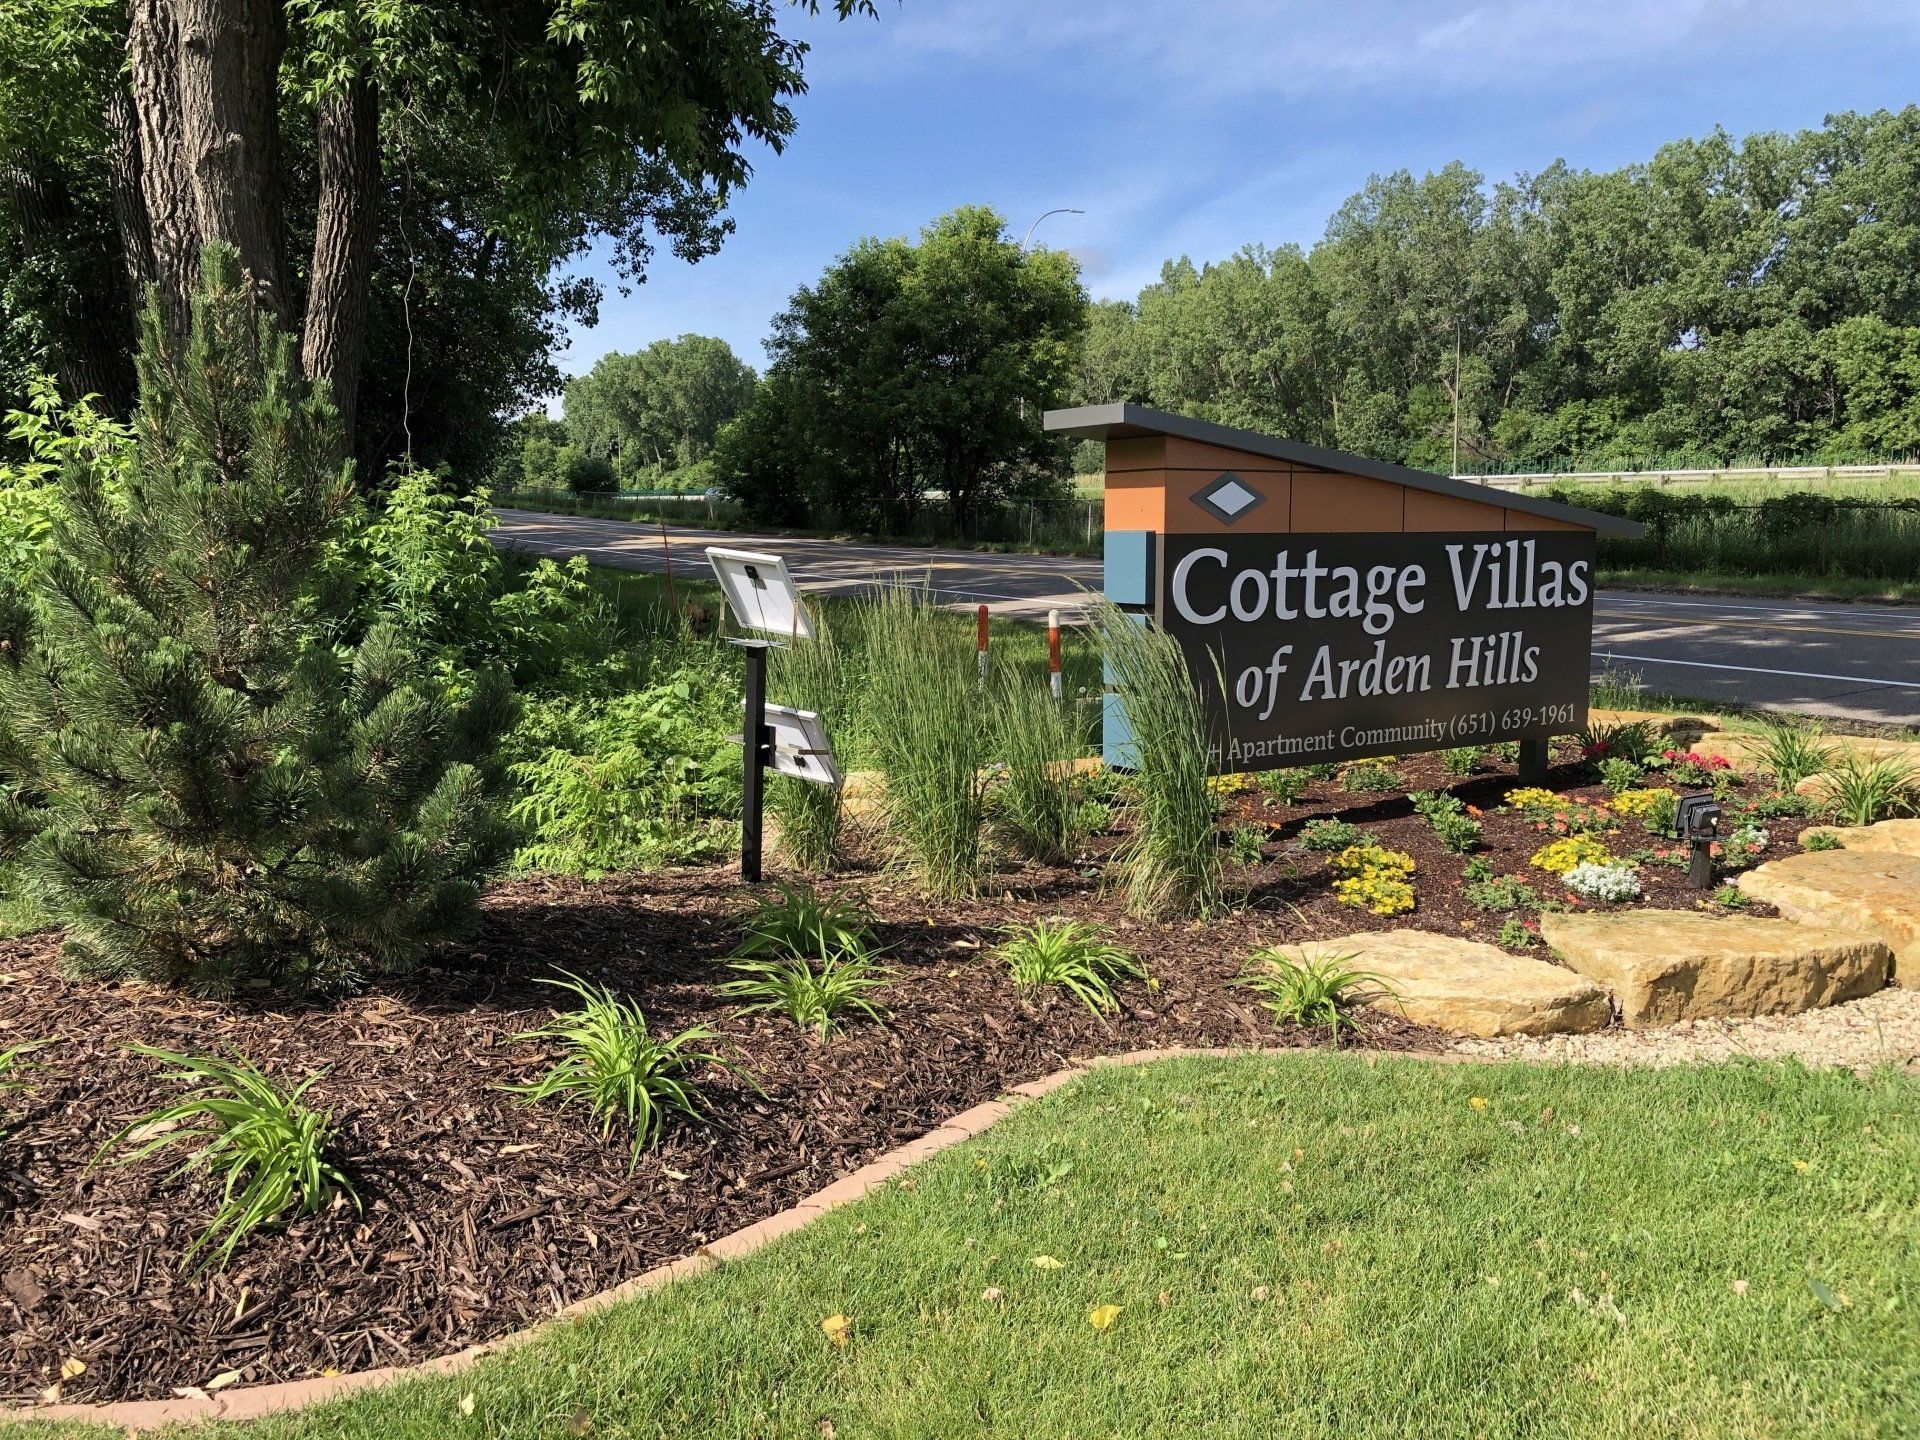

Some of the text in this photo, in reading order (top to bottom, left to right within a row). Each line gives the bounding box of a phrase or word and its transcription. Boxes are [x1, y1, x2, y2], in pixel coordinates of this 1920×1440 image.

[1172, 539, 1588, 635] Cottage Villas
[1236, 630, 1540, 720] of Arden Hills
[1226, 734, 1335, 764] Apartment
[1340, 717, 1447, 744] Community
[1449, 710, 1496, 740] (651)
[1501, 703, 1575, 730] 639-1961
